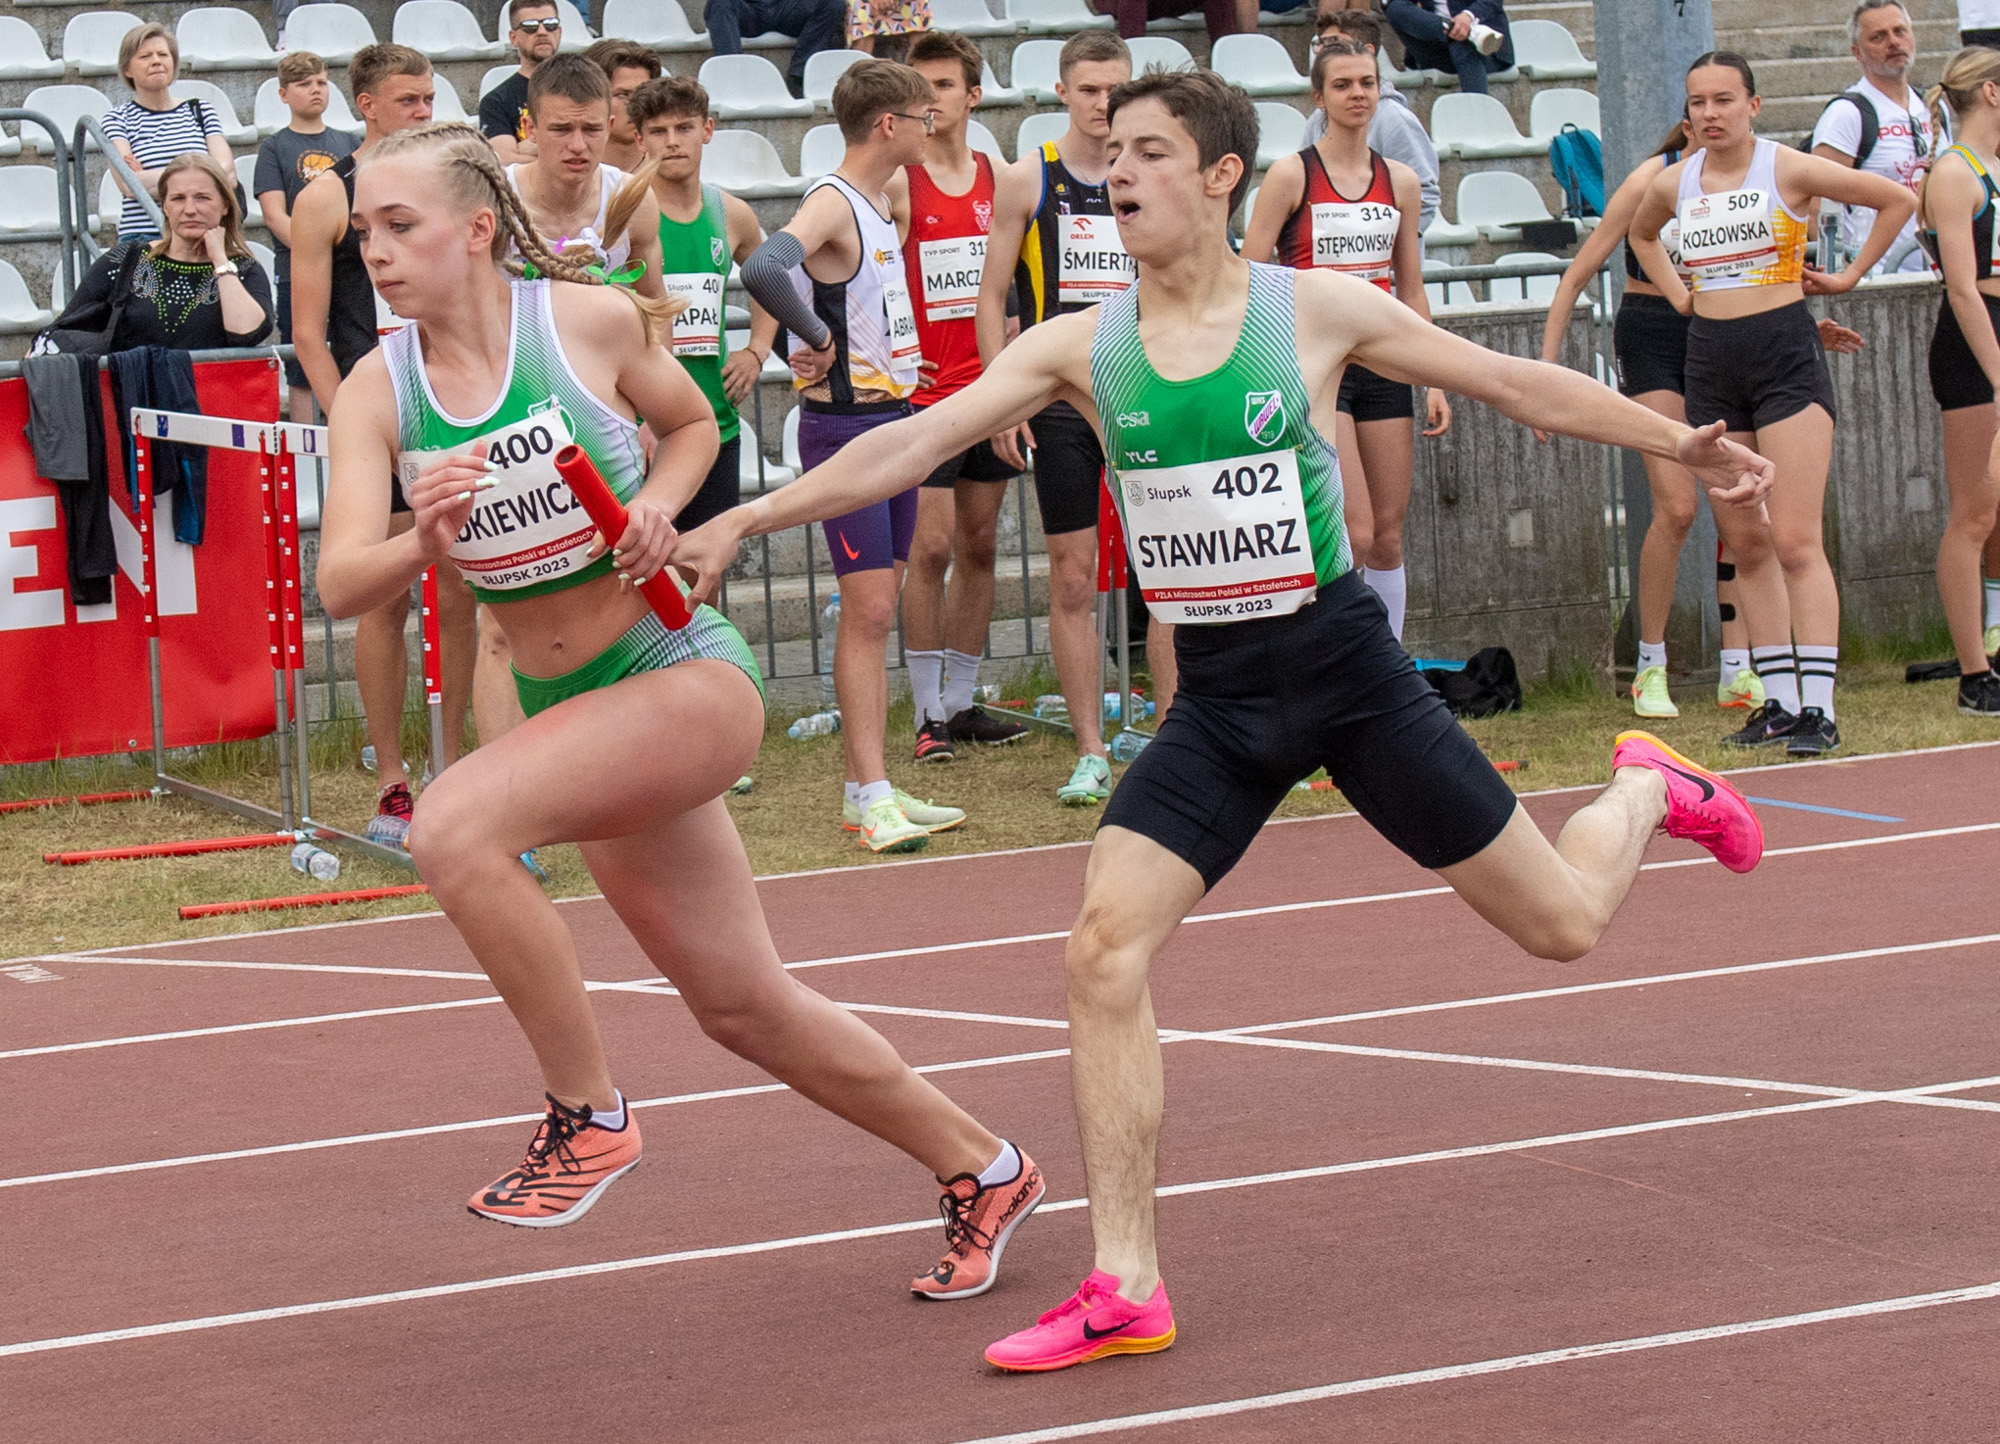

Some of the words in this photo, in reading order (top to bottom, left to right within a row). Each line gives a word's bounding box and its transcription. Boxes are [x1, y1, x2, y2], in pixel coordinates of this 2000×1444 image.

[1728, 193, 1760, 211] 509
[1361, 206, 1393, 222] 314
[1682, 221, 1770, 250] KOZŁOWSKA
[939, 247, 961, 255] SPORT
[969, 241, 987, 256] 31
[1705, 264, 1734, 274] SŁUPSK
[1735, 260, 1755, 270] 2023
[667, 284, 694, 293] Słupsk
[489, 425, 554, 470] 400
[1125, 449, 1159, 463] TLC
[1212, 462, 1282, 500] 402
[1147, 485, 1193, 501] Słupsk
[512, 552, 538, 563] Polski
[538, 549, 546, 557] w
[547, 530, 593, 553] Sztafetach
[1138, 518, 1301, 569] STAWIARZ
[481, 568, 532, 586] SŁUPSK
[533, 556, 570, 577] 2023
[1154, 592, 1173, 600] PZLA
[1173, 590, 1217, 600] Mistrzostwa
[1217, 588, 1243, 598] Polski
[1252, 578, 1301, 593] Sztafetach
[1184, 604, 1233, 617] SŁUPSK
[1235, 598, 1273, 614] 2023
[999, 1165, 1041, 1223] balance
